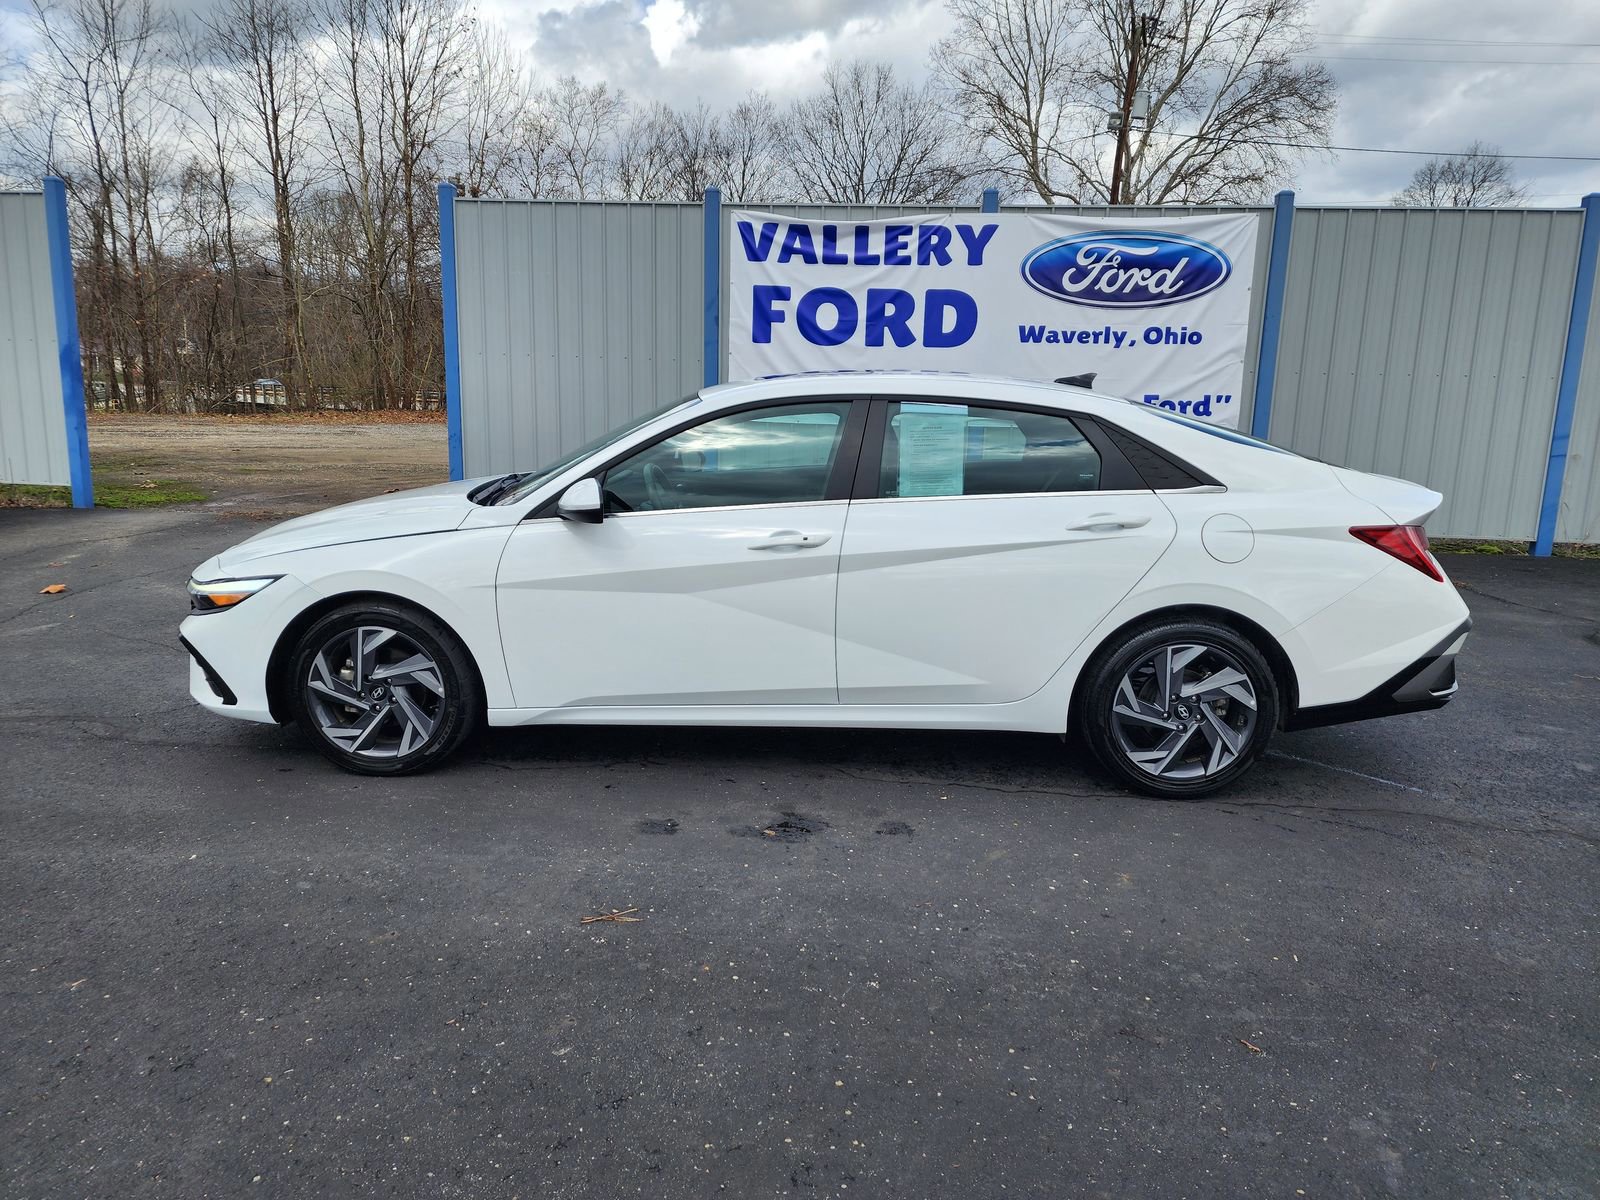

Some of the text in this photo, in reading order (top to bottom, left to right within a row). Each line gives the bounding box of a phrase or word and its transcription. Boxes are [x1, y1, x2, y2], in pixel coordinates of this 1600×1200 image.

[737, 221, 998, 266] VALLERY
[1062, 244, 1188, 296] Ford
[752, 285, 978, 348] FORD
[1019, 325, 1202, 348] Waverly, Ohio
